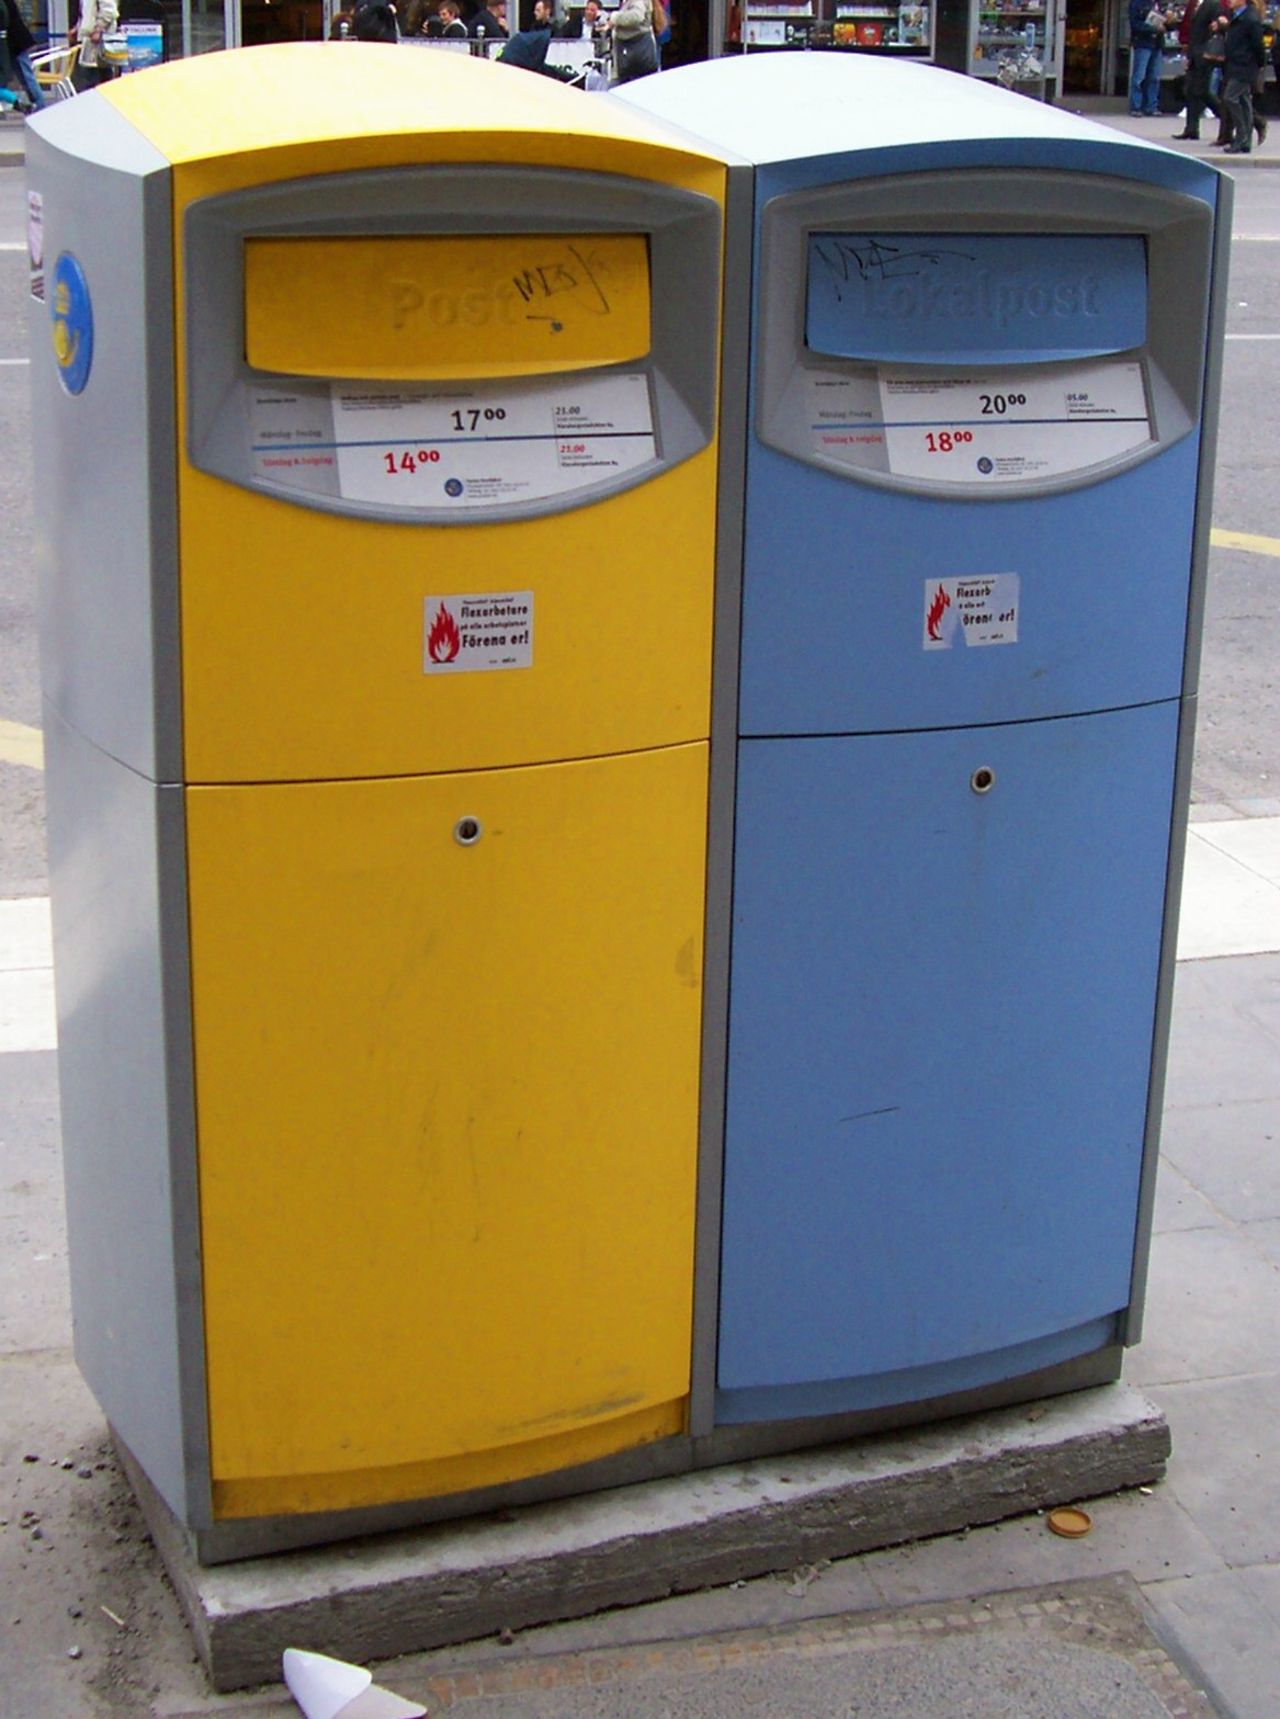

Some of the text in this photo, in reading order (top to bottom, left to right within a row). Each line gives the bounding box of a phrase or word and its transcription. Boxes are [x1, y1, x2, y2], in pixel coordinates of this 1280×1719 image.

[391, 279, 517, 330] Post
[461, 605, 528, 618] Flexarbetare
[999, 609, 1015, 622] er!
[462, 630, 529, 648] Förena er!
